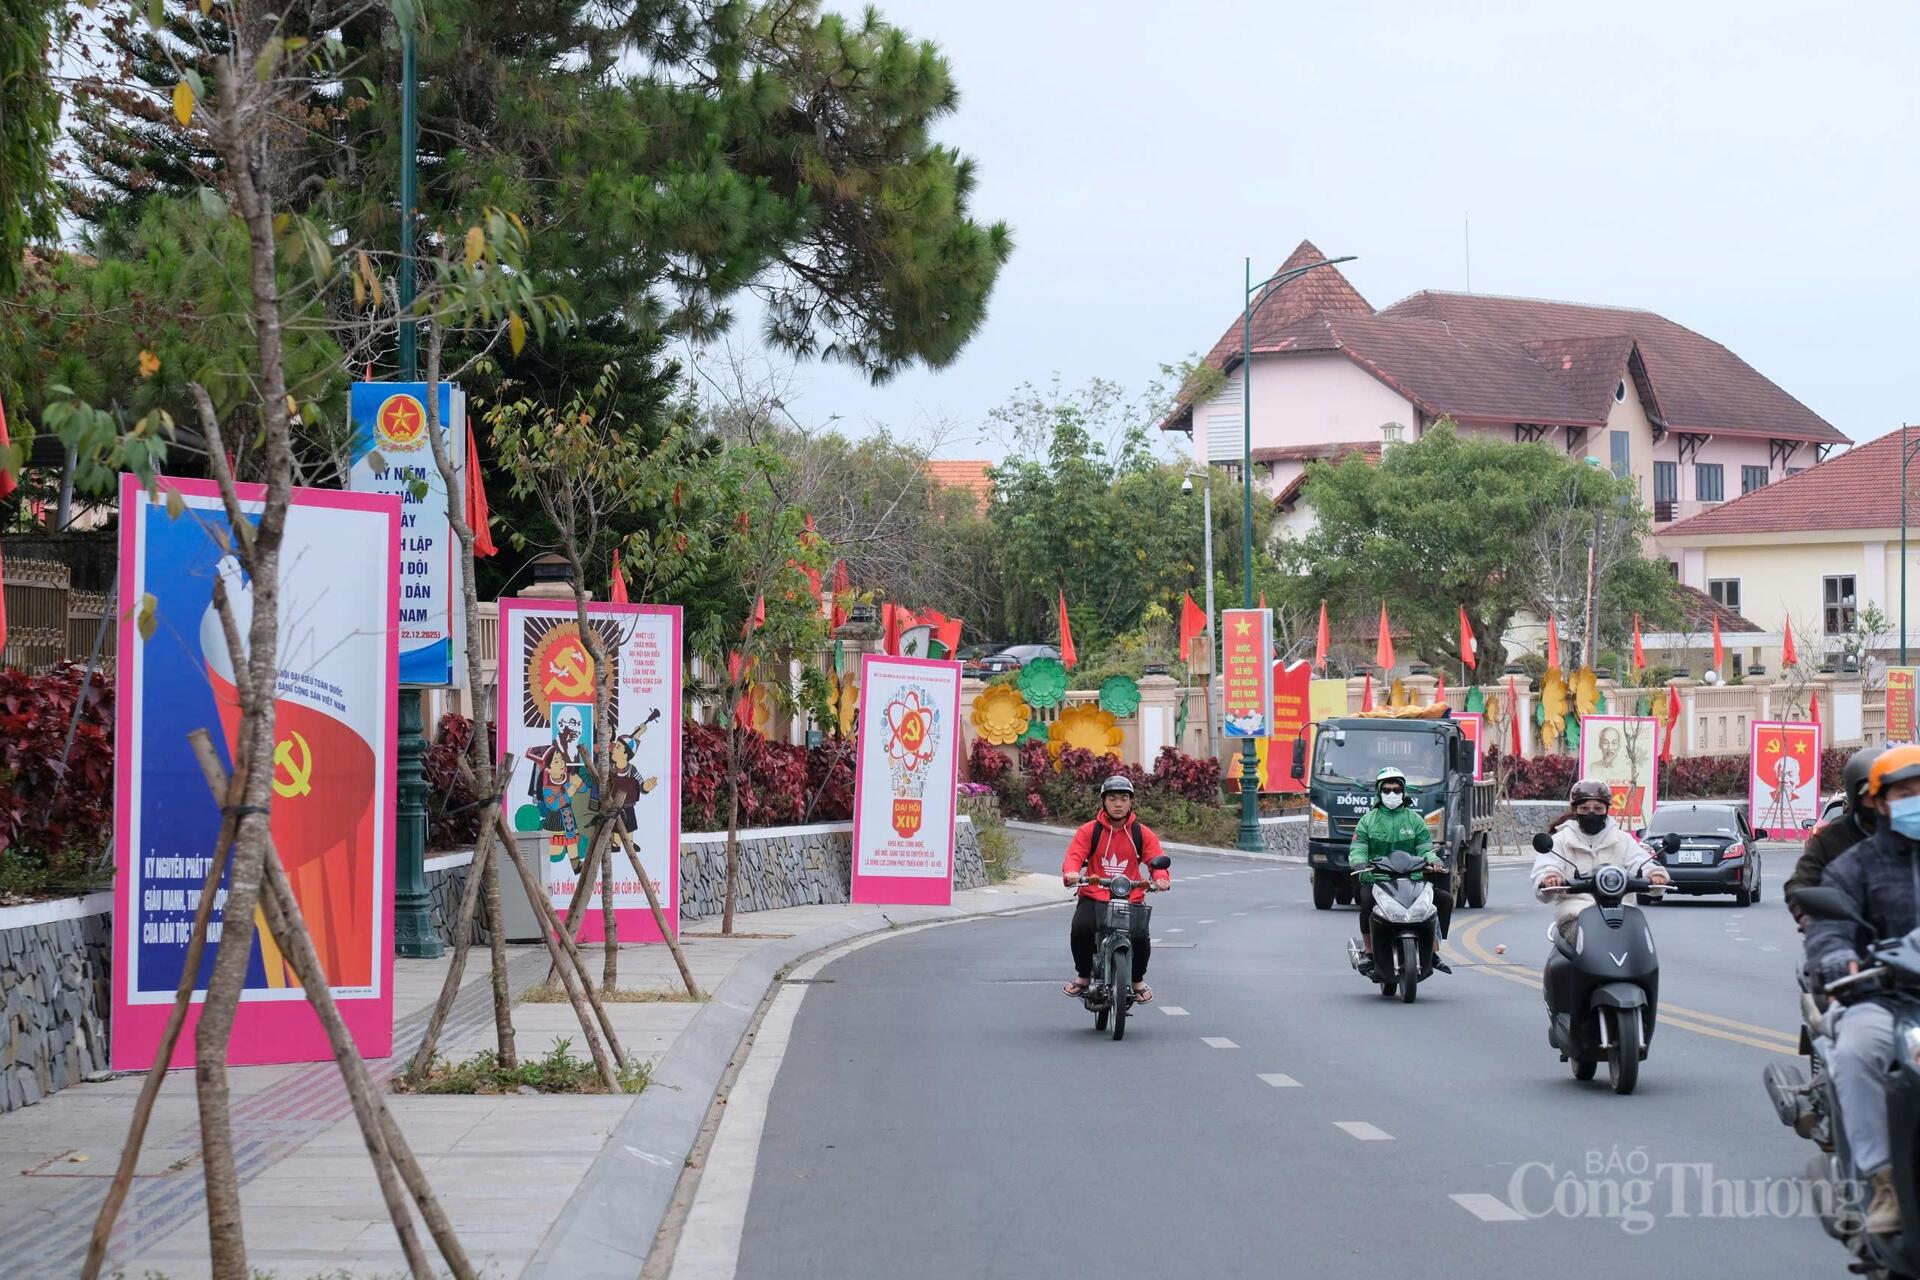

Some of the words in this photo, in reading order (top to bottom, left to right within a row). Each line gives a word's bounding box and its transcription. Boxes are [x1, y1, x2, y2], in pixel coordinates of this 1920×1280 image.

[410, 536, 433, 554] LẬP
[407, 559, 428, 578] ĐỘI
[405, 583, 431, 599] DÂN
[400, 609, 427, 622] NAM
[895, 803, 907, 815] ĐẠI
[908, 801, 920, 815] HỘI
[896, 816, 919, 829] XIV
[145, 848, 155, 879] KỶ
[155, 853, 184, 879] NGUYÊN
[185, 853, 203, 879] PHÁT
[144, 884, 162, 911] GIÀU
[162, 889, 186, 916] MẠNH,
[143, 913, 158, 944] CỦA
[159, 918, 174, 944] DÂN
[176, 917, 190, 948] TỘC
